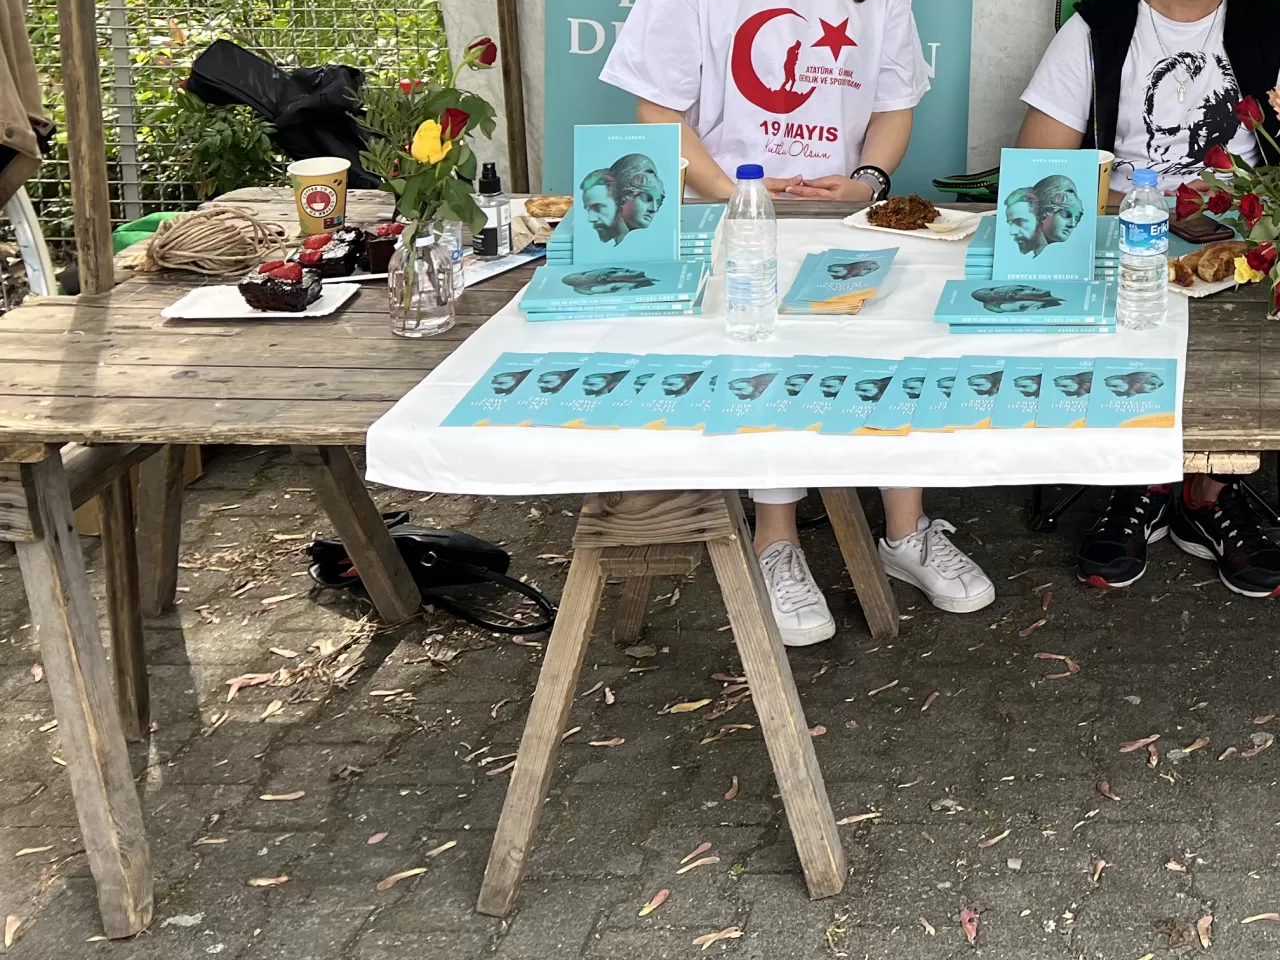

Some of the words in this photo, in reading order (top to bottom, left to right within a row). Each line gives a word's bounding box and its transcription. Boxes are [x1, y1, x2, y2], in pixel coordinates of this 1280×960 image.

[820, 76, 829, 85] VE
[759, 120, 781, 137] 19
[783, 122, 839, 143] MAYIS
[788, 140, 831, 159] Olsun
